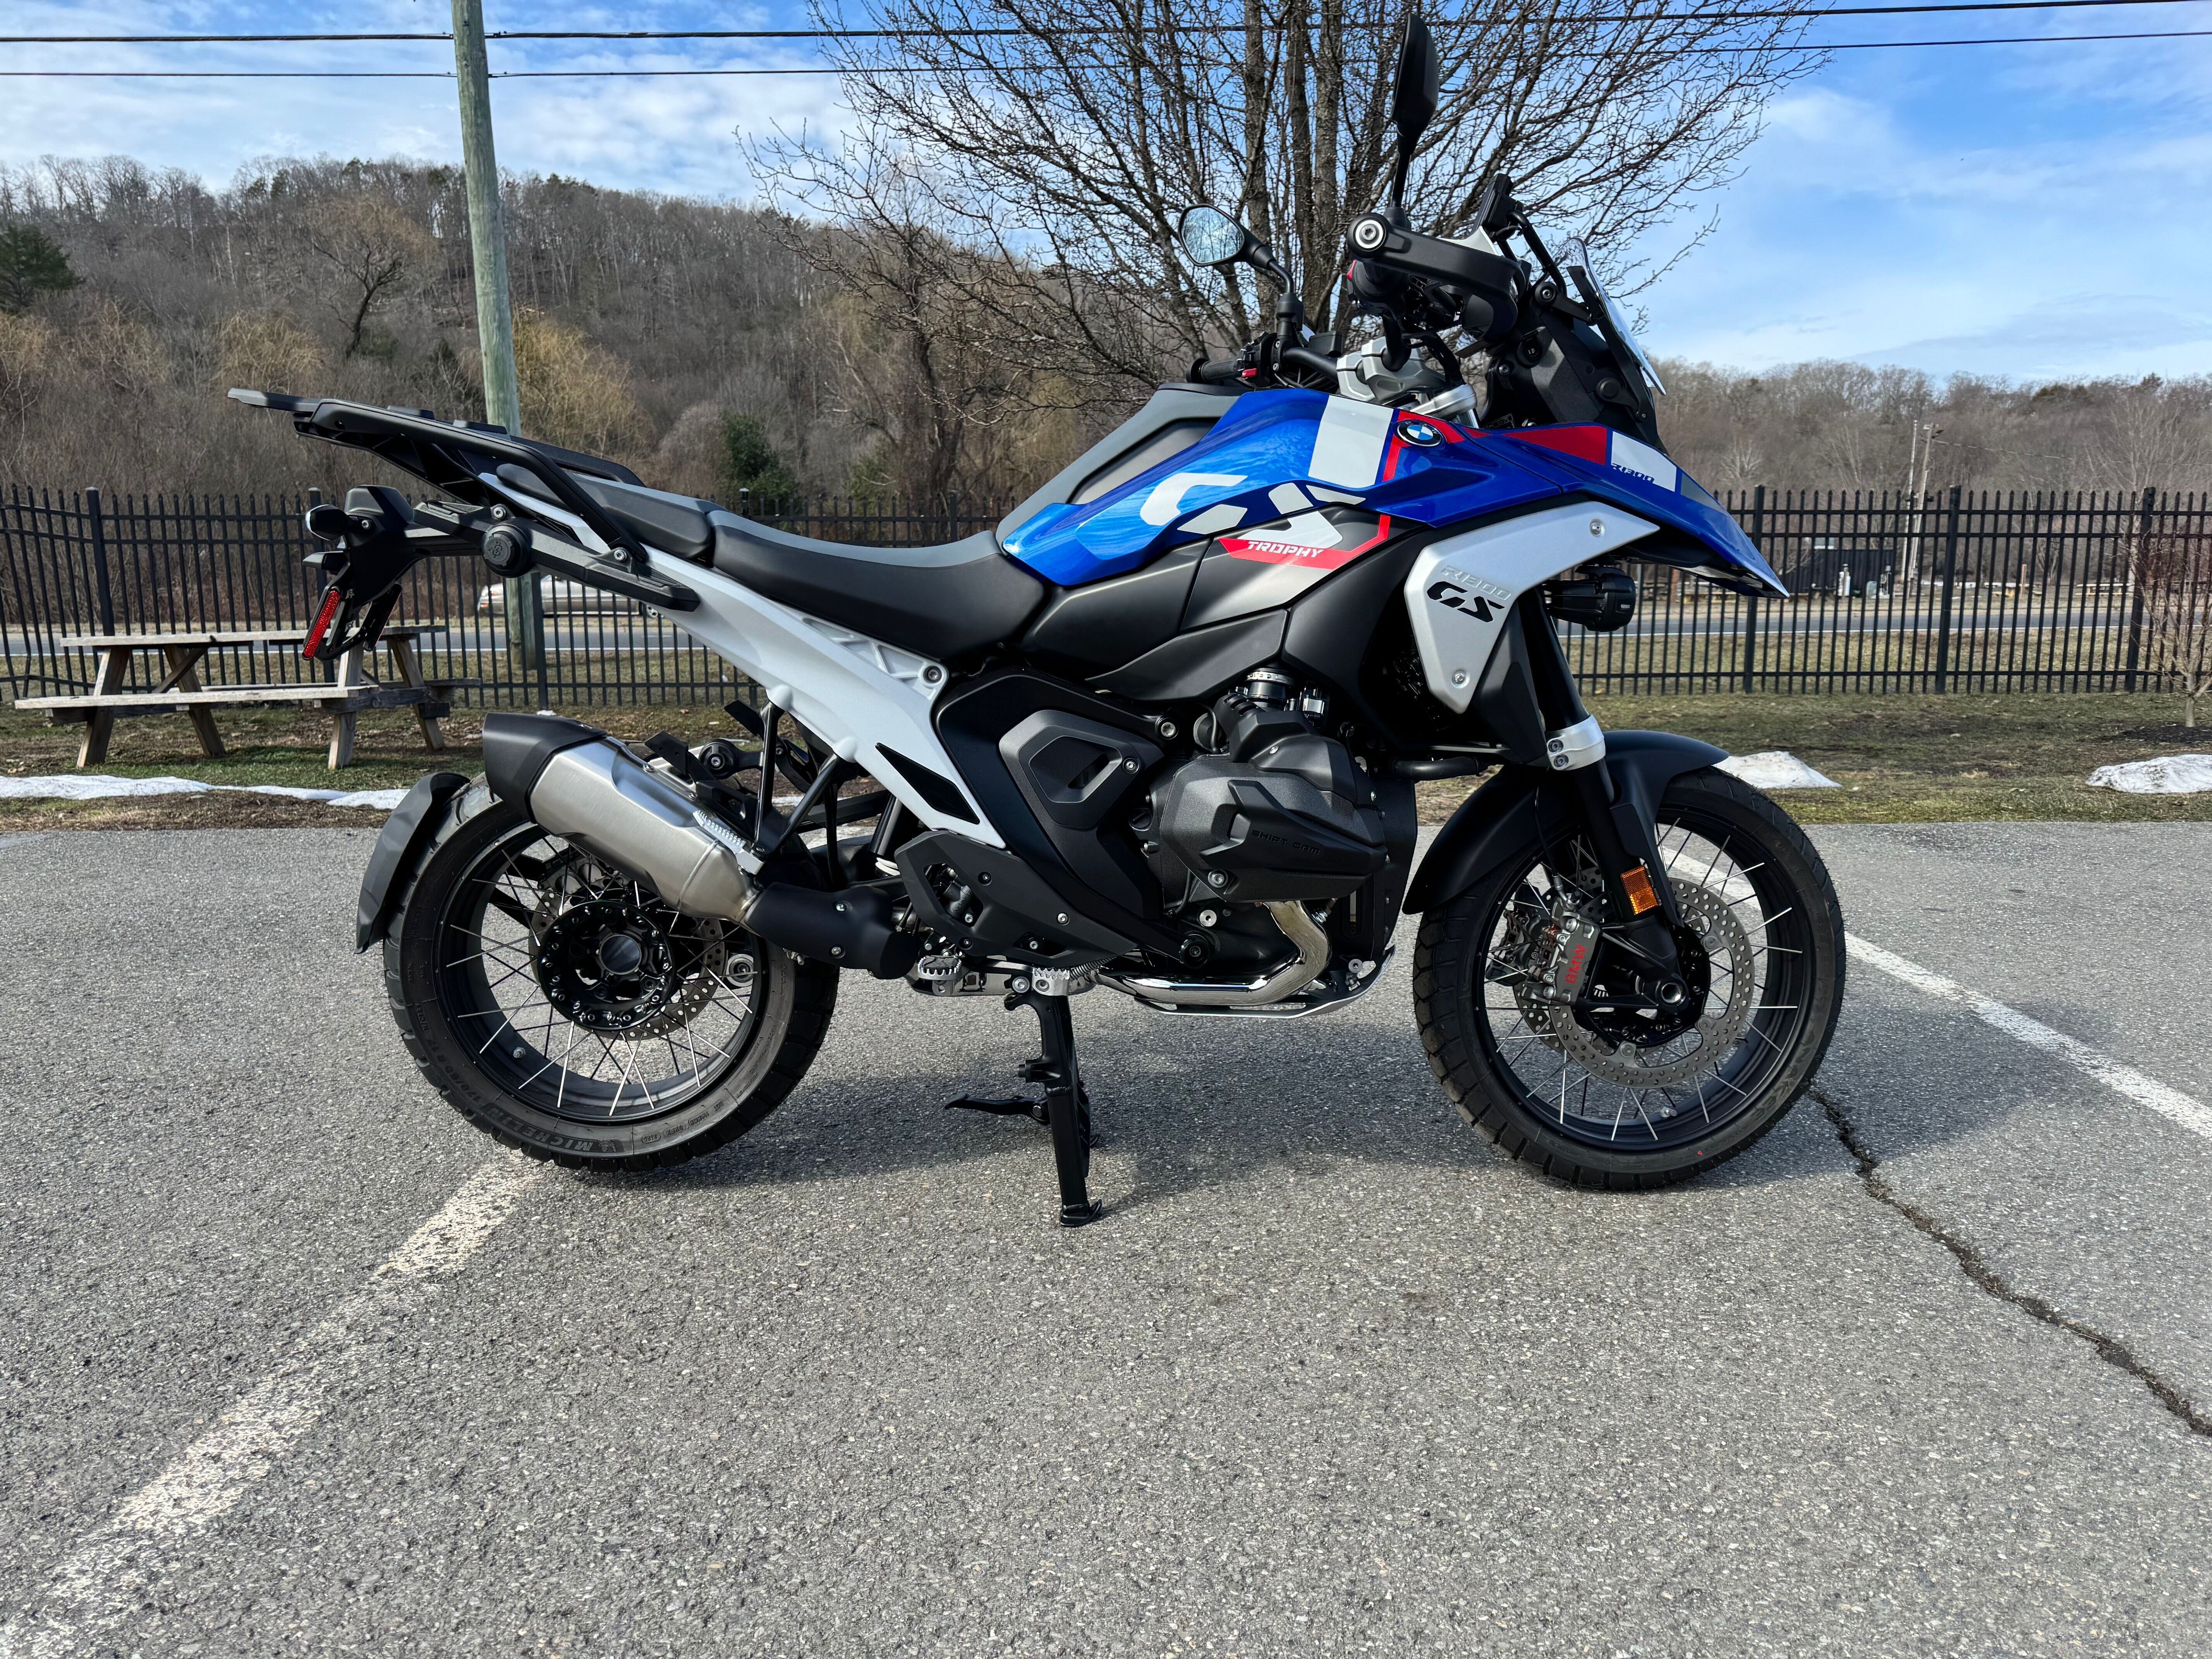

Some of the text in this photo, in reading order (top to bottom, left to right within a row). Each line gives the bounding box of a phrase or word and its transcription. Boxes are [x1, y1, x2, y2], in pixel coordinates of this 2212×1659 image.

[1248, 541, 1324, 558] TROPHY
[1427, 581, 1505, 623] GS
[1441, 565, 1511, 600] R1300
[1251, 830, 1320, 855] SHIFT CAM
[1565, 944, 1586, 984] BMW
[426, 1036, 482, 1104] 170/60 R 17
[487, 1108, 594, 1152] MICHELIN
